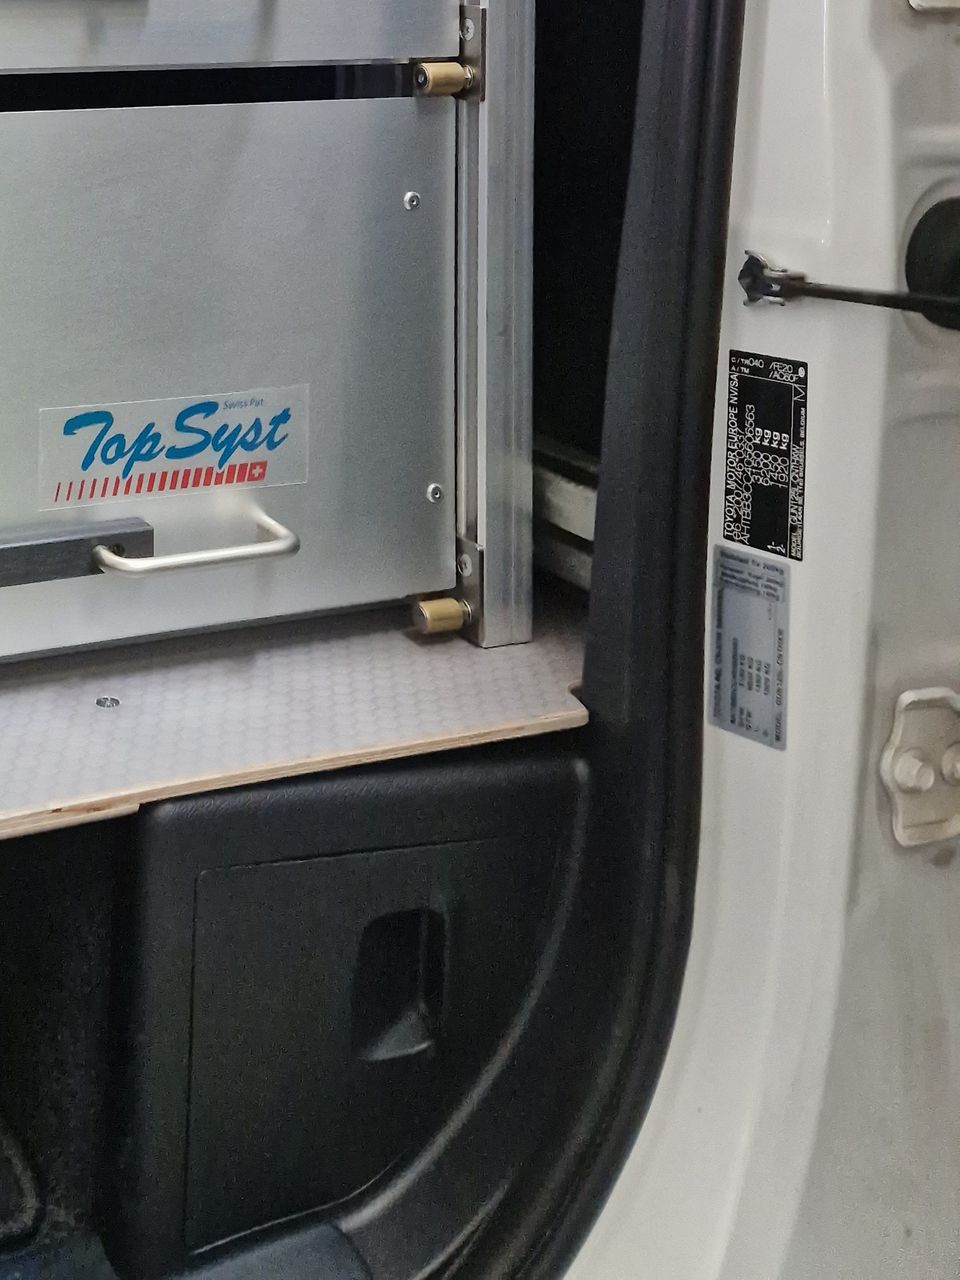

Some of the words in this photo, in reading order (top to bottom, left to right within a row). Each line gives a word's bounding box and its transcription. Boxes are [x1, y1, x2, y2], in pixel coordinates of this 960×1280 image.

[729, 373, 738, 404] NV/SA
[63, 401, 292, 479] TopSyst
[728, 406, 738, 449] EUROPE
[753, 427, 762, 444] kg
[762, 429, 771, 446] kg
[771, 431, 780, 448] kg
[780, 433, 790, 450] kg
[727, 450, 736, 489] MOTOR
[724, 494, 734, 537] TOYOTA
